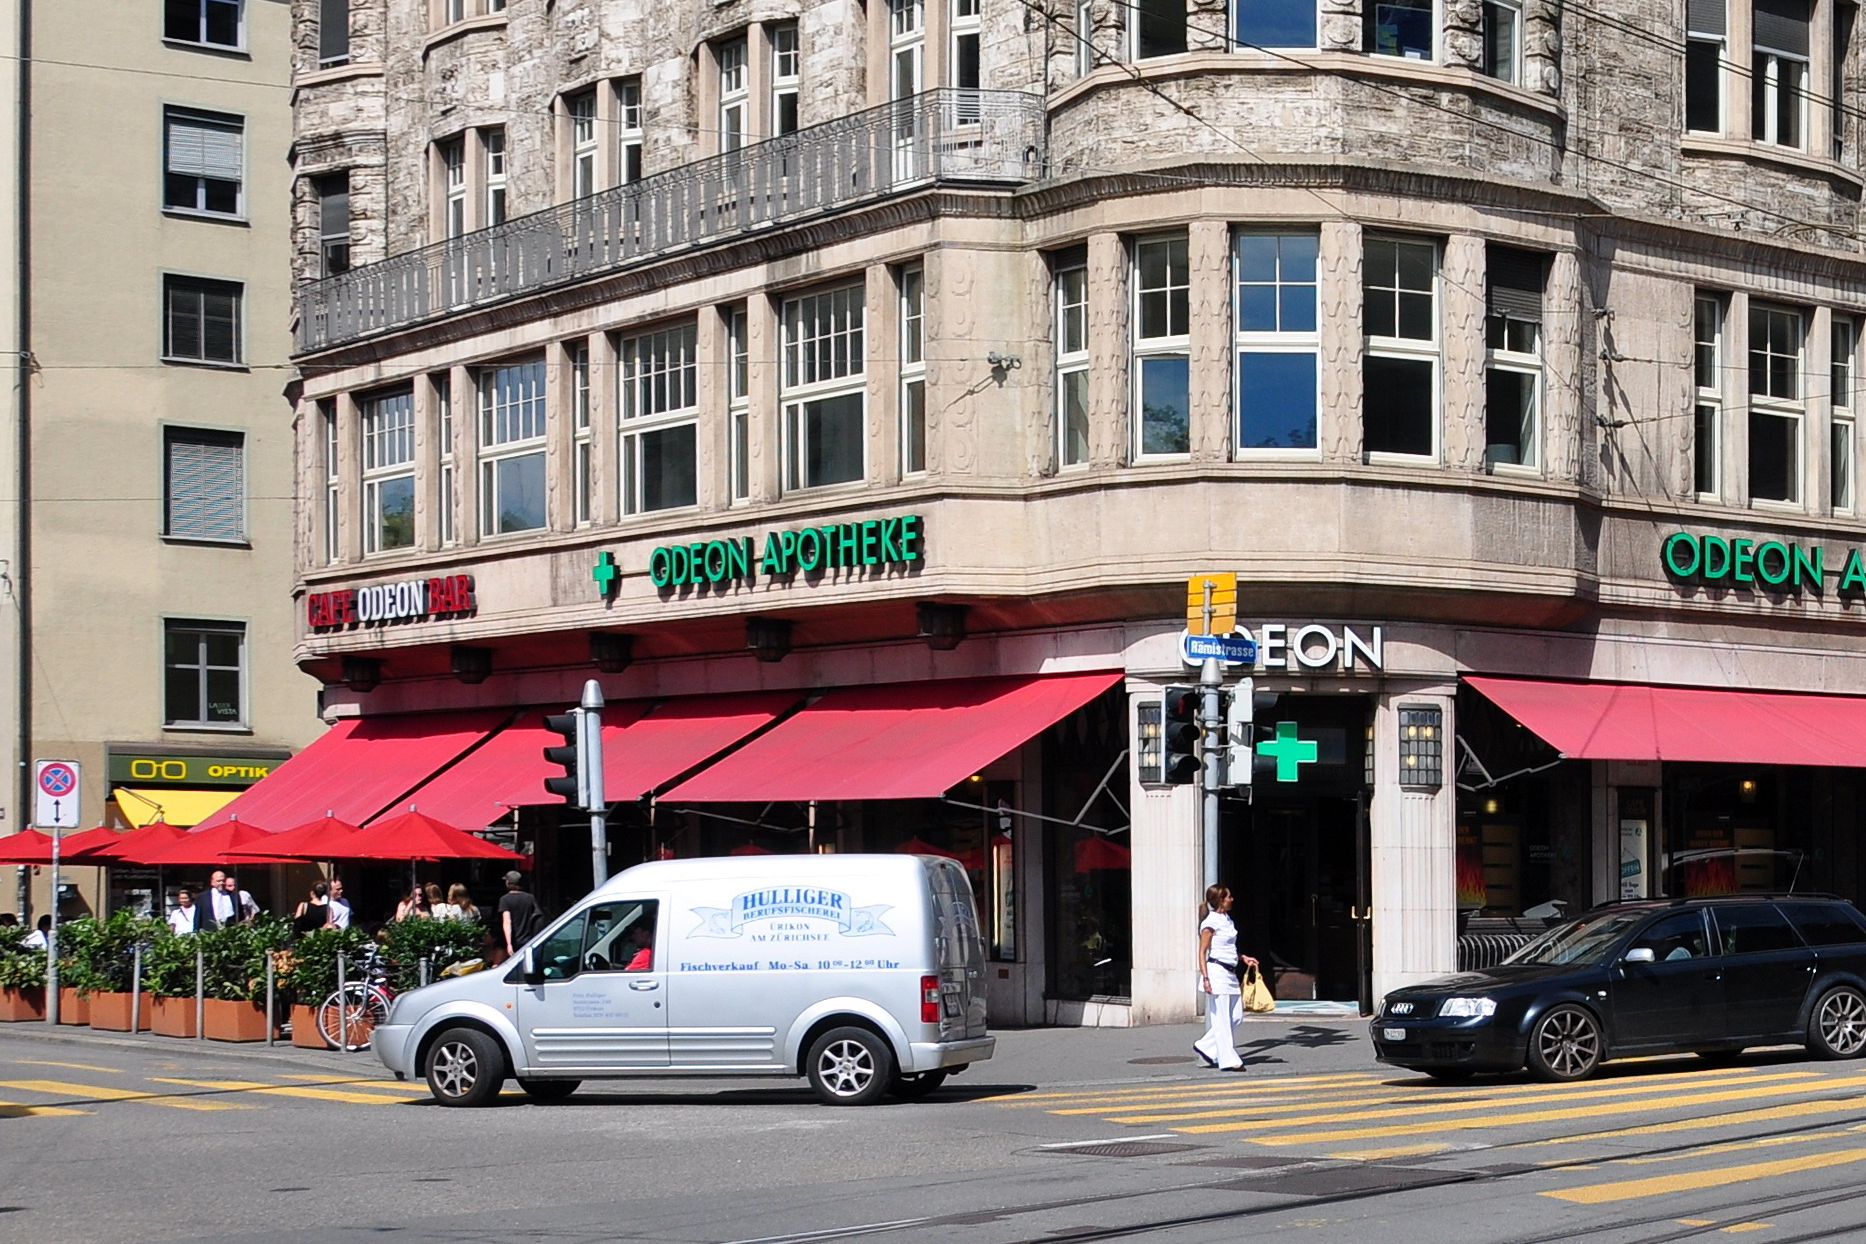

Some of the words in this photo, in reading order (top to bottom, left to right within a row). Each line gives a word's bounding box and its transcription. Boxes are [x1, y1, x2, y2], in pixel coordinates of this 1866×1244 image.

[648, 539, 748, 588] ODEON
[760, 515, 918, 574] APOTHEKE
[1665, 531, 1824, 588] ODEON
[308, 589, 355, 627] CAFE
[357, 580, 425, 622] ODEON
[428, 575, 476, 614] BAR
[1190, 640, 1255, 659] Rämistrasse
[207, 765, 269, 778] OPTIK
[742, 888, 843, 911] HULLIGER
[742, 905, 841, 920] BERUFSFISCHEREI
[751, 933, 767, 942] AM
[769, 932, 831, 942] ZÜRICHSEE
[680, 961, 760, 972] Fischverkauf
[877, 959, 901, 970] Uhr
